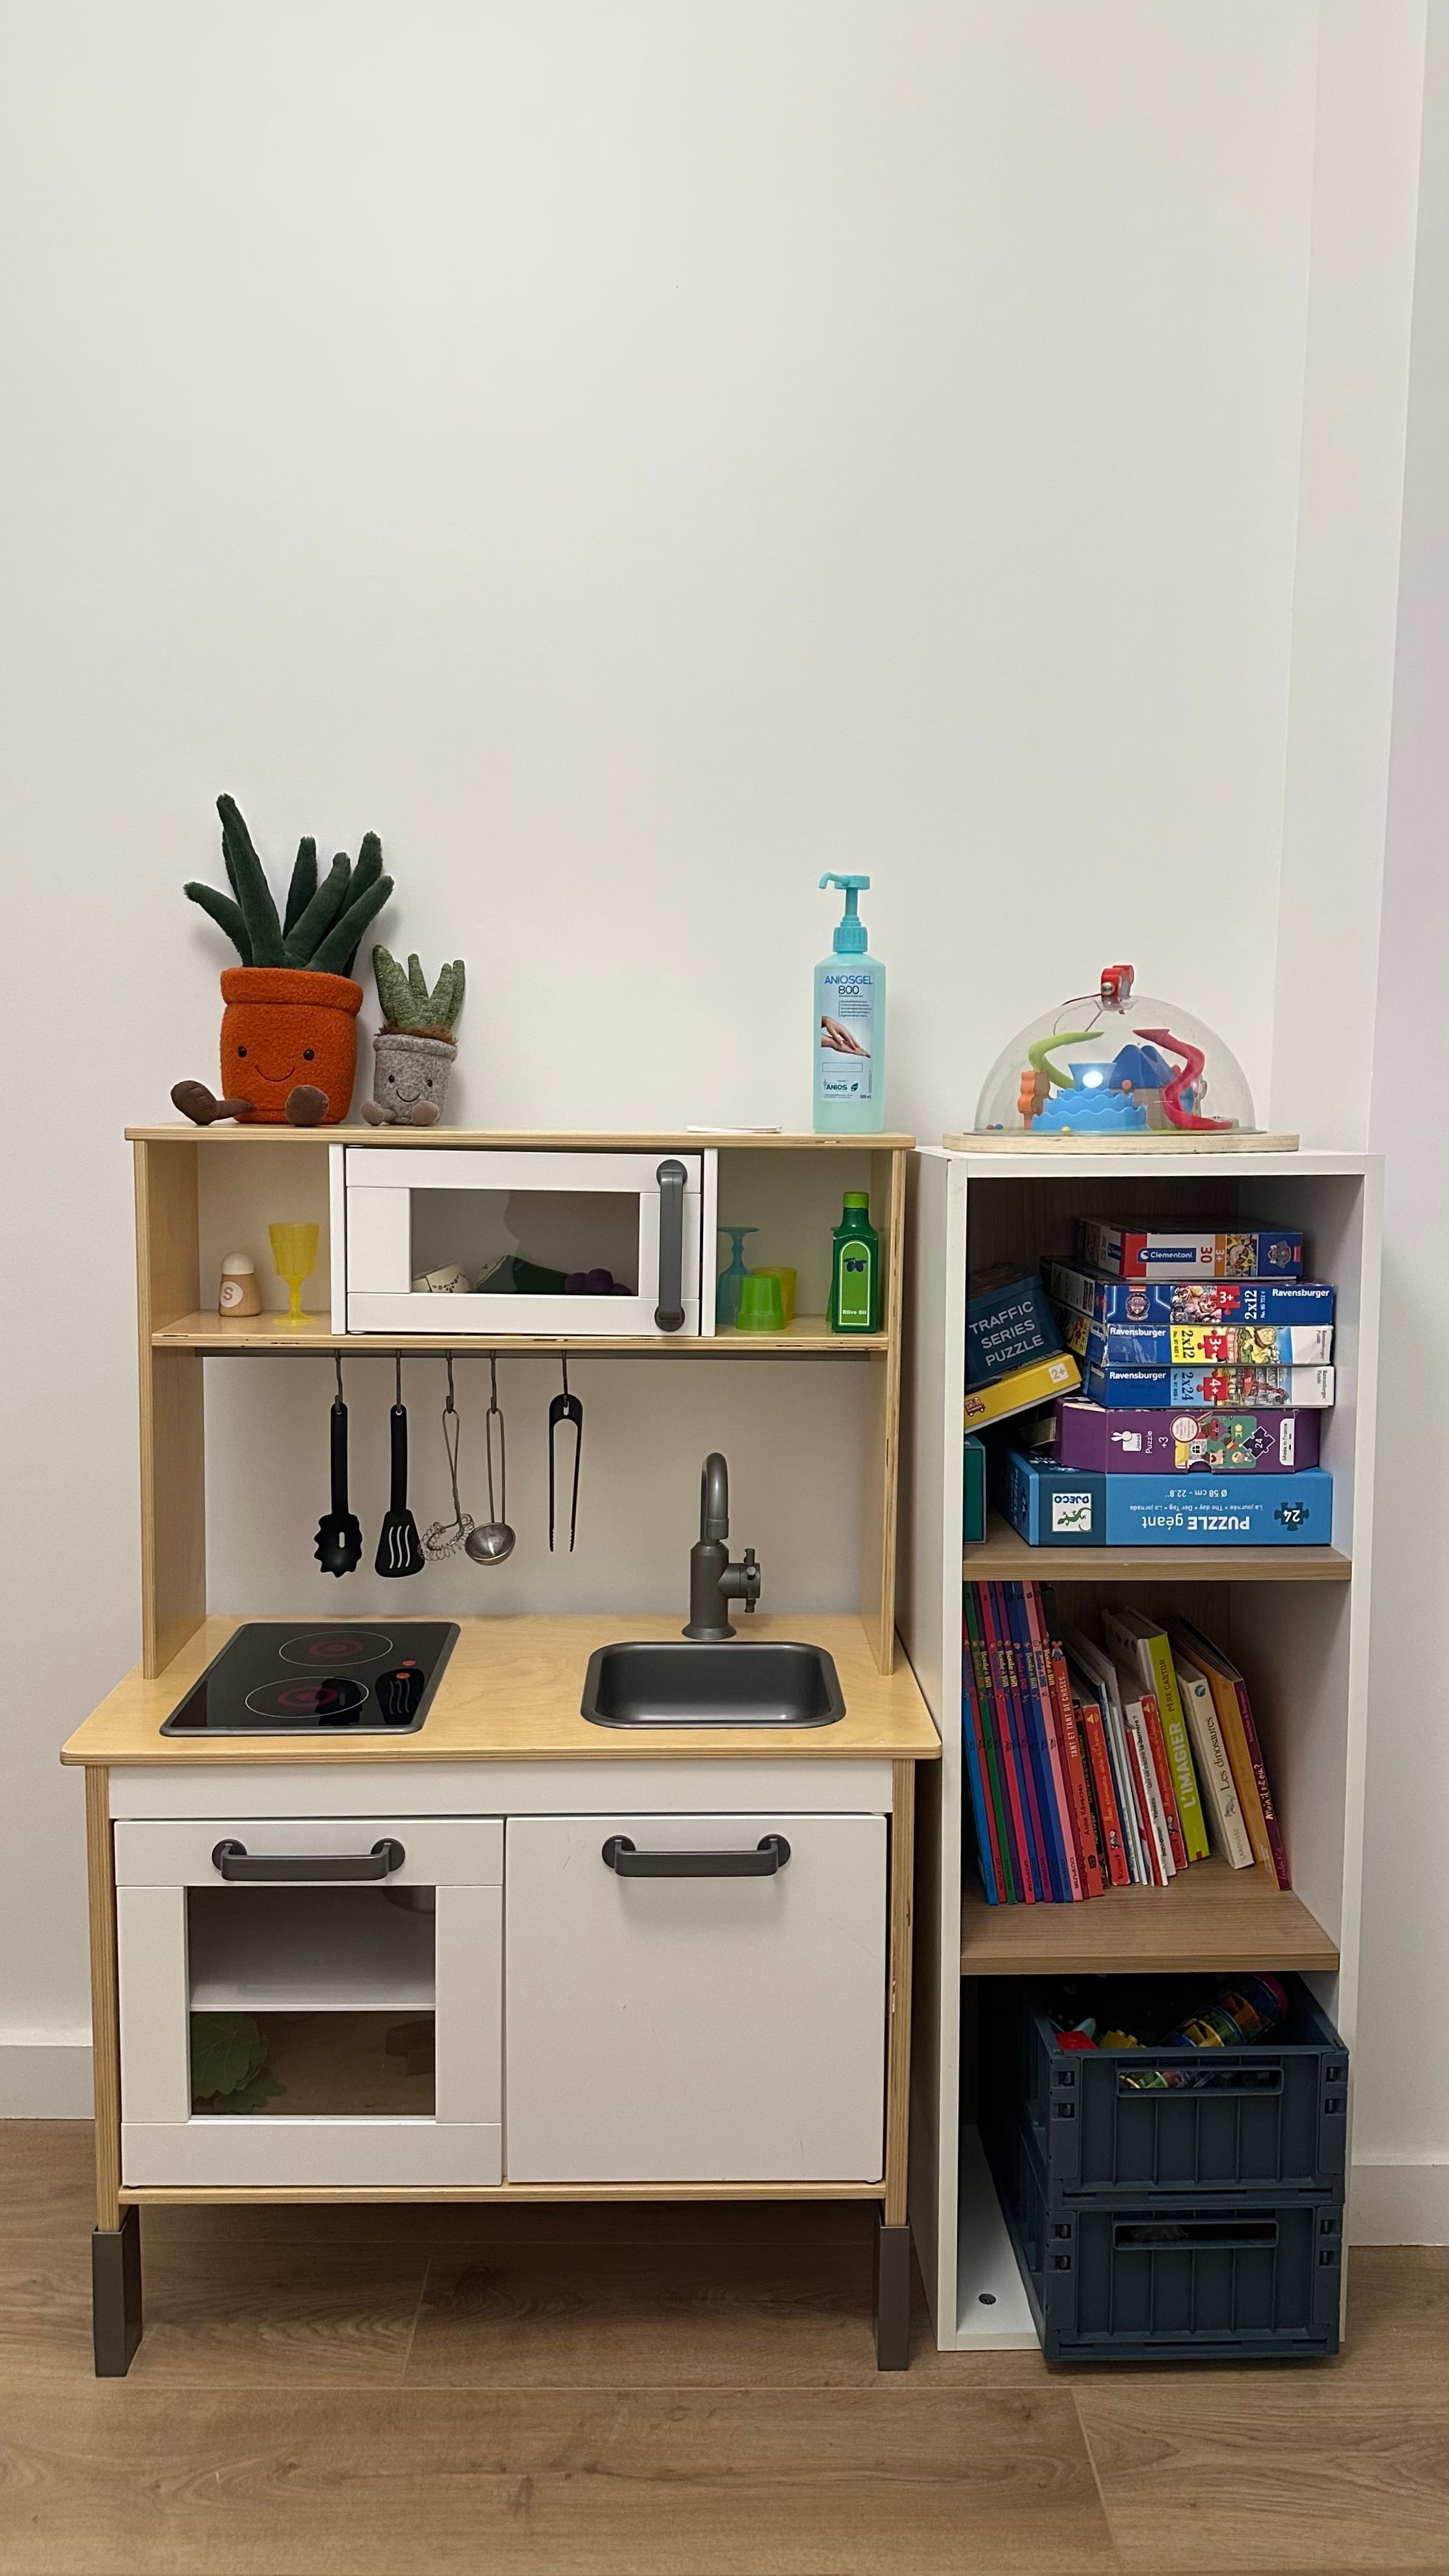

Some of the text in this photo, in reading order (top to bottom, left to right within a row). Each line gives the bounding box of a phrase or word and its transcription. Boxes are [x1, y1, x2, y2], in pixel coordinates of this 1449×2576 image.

[824, 975, 873, 985] ANIOSGEL
[838, 985, 859, 995] 800
[1150, 1251, 1193, 1259] Clementoni
[1201, 1246, 1212, 1263] 30
[1216, 1249, 1225, 1262] 3+
[223, 1287, 233, 1301] S
[1219, 1291, 1234, 1304] 3+
[1272, 1289, 1331, 1298] Ravensburger
[1244, 1290, 1257, 1320] 2x12
[968, 1301, 1034, 1335] TRAFFIC
[981, 1319, 1035, 1349] SERIES
[1110, 1327, 1166, 1338] Ravensburger
[985, 1334, 1044, 1367] PUZZLE
[1181, 1330, 1196, 1359] 2x12
[1209, 1337, 1221, 1352] 3+
[1051, 1367, 1066, 1380] 2+
[1110, 1371, 1166, 1381] Ravensburger
[1181, 1372, 1195, 1400] 2x24
[1209, 1378, 1222, 1395] 4+
[1158, 1437, 1169, 1449] +3
[1255, 1438, 1263, 1449] 24
[1054, 1495, 1089, 1504] DJECO
[1141, 1513, 1250, 1531] PUZZLE géant
[1283, 1510, 1301, 1522] 24
[1006, 1650, 1015, 1670] Boule
[1044, 1648, 1054, 1666] Boule
[1159, 1659, 1175, 1713] PÈRE CASTOR
[1063, 1702, 1070, 1712] DE
[1064, 1711, 1073, 1729] TANT
[1066, 1731, 1075, 1740] ET
[1069, 1742, 1079, 1758] TANT
[1204, 1716, 1230, 1791] Les dinosaures
[1169, 1722, 1197, 1809] L'IMAGIER
[1082, 1817, 1091, 1836] Anna
[1070, 1857, 1079, 1889] DUPUIS
